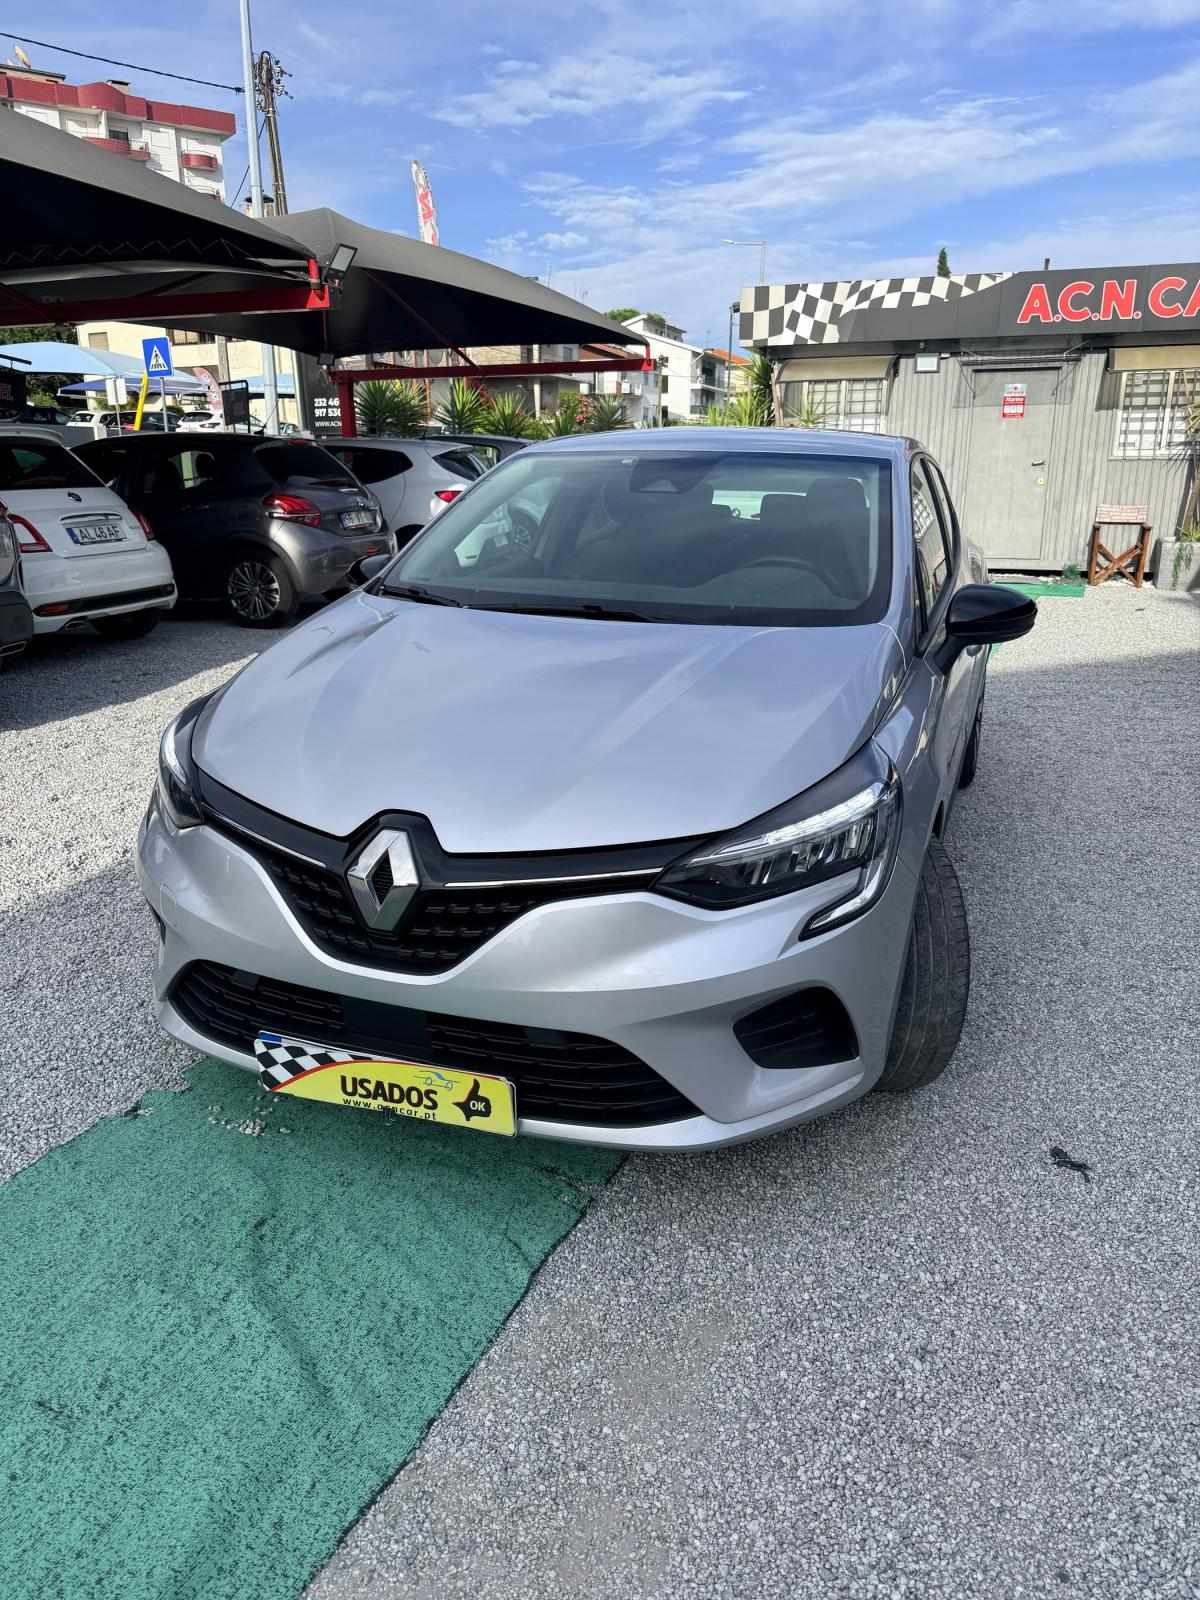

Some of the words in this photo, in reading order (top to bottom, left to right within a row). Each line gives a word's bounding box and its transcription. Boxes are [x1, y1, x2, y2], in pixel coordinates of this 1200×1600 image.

[1017, 279, 1142, 324] A.C.N.
[328, 398, 340, 406] 46
[340, 1075, 438, 1110] USADOS
[469, 1099, 486, 1113] OK
